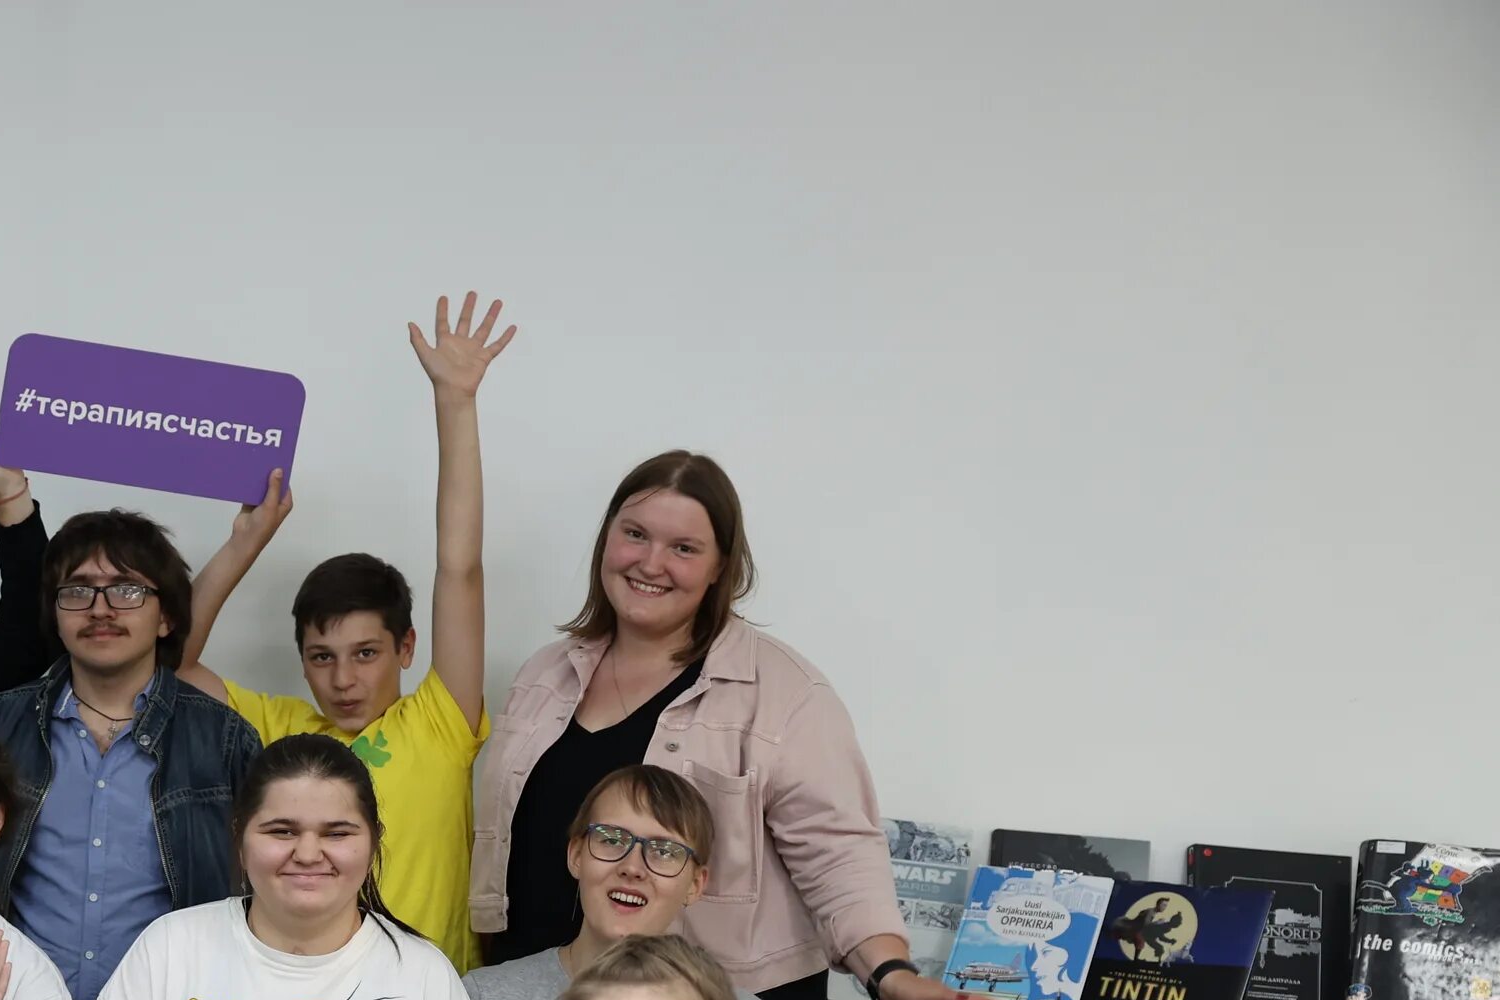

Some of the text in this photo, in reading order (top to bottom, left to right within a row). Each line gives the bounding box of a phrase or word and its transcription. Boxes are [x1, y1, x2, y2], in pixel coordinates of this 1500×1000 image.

[14, 387, 283, 448] #терапиясчастья
[892, 863, 958, 886] WARS
[1024, 900, 1042, 909] Uusi
[1000, 916, 1054, 931] OPPIKIRJA
[1363, 933, 1466, 958] the comics
